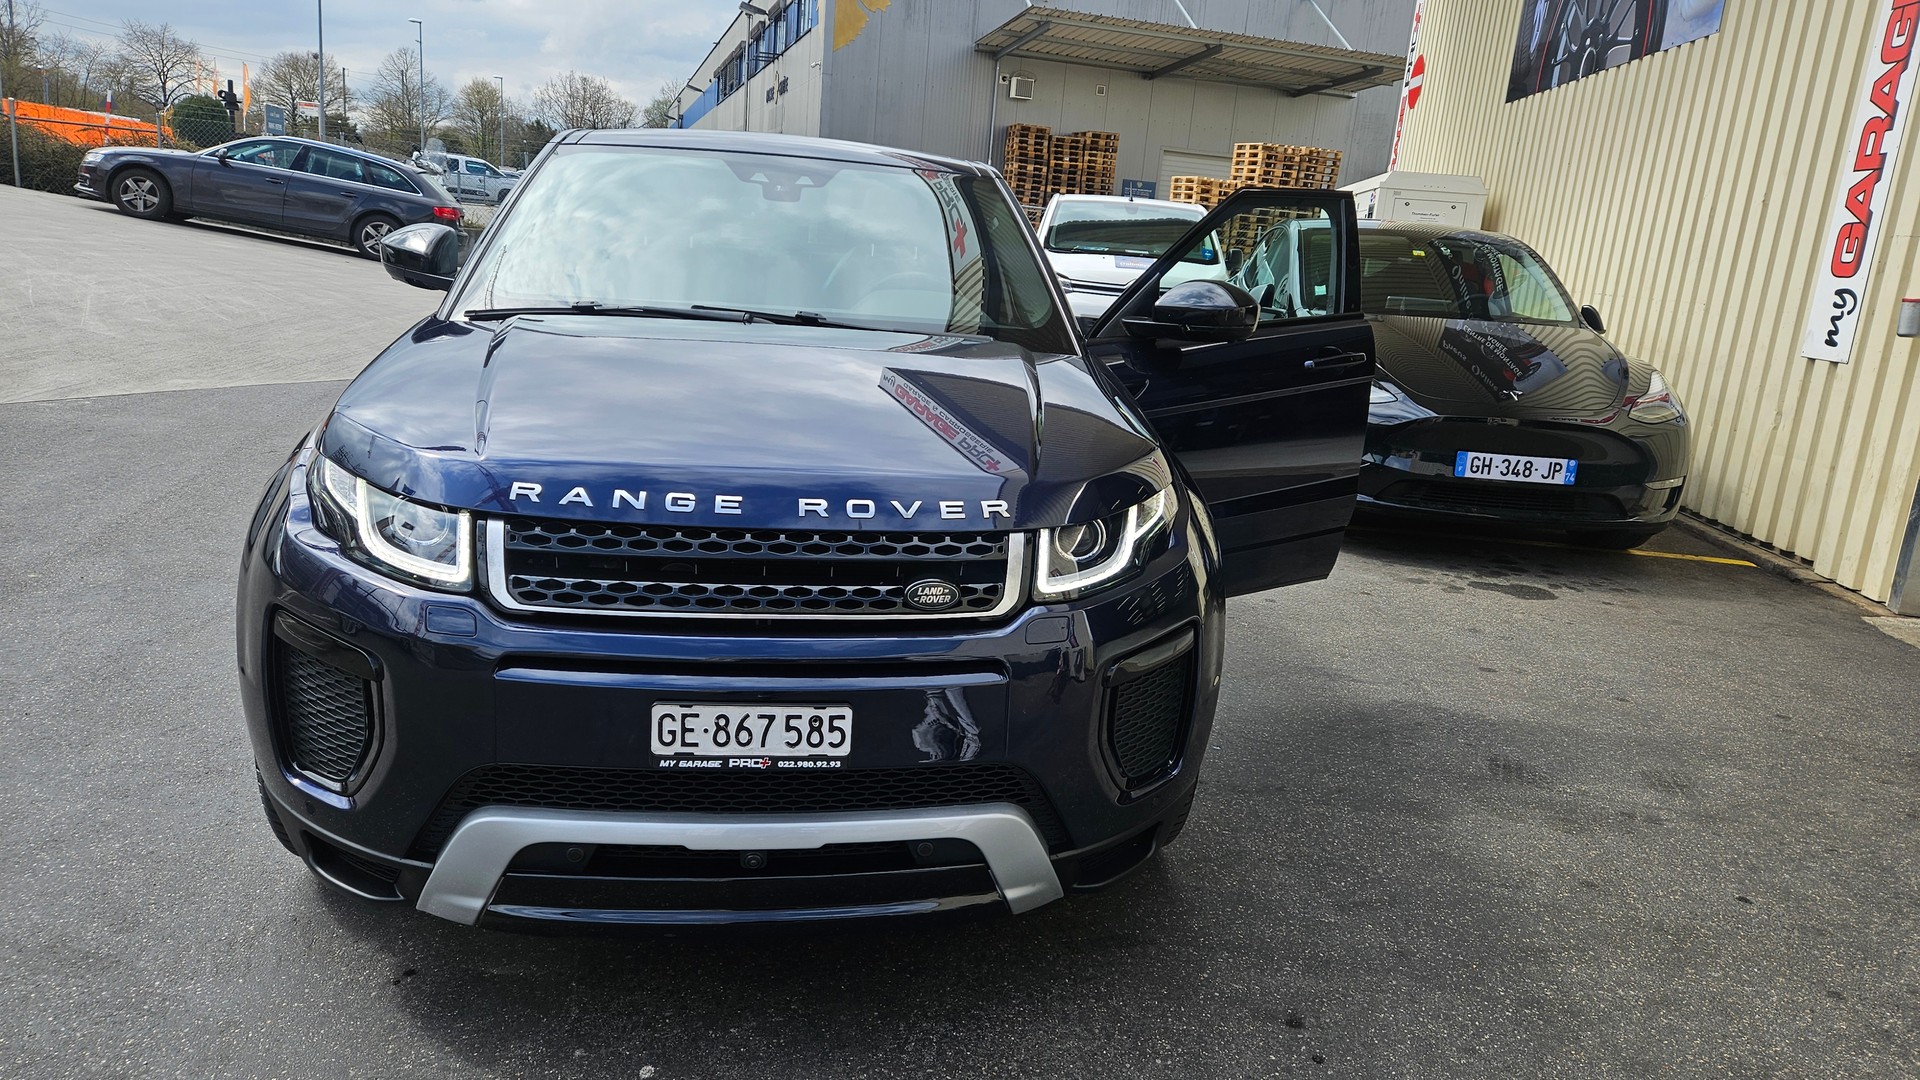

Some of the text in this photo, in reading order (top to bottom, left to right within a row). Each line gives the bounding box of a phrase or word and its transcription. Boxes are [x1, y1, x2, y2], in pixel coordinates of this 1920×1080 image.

[1824, 0, 1920, 347] my GARAG
[1469, 455, 1563, 480] GH-348-JP
[1565, 472, 1576, 482] 74
[509, 481, 1011, 519] RANGE ROVER
[917, 587, 944, 595] LAND
[919, 595, 951, 603] ROVER
